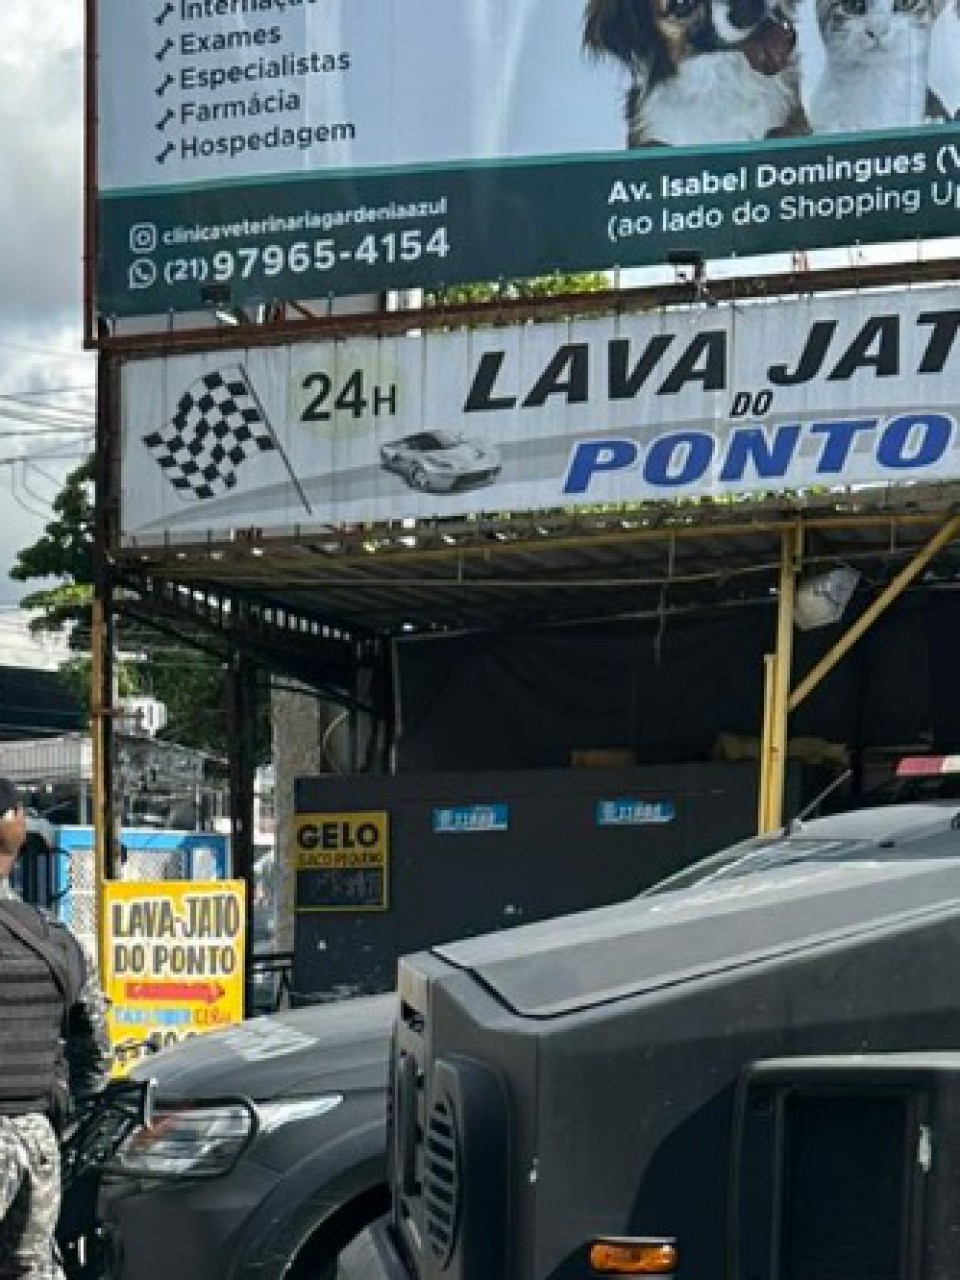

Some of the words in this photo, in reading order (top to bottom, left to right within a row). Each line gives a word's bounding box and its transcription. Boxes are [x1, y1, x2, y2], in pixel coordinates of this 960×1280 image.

[181, 25, 281, 55] Exames
[181, 52, 351, 90] Especialistas
[181, 89, 300, 125] Farmácia
[181, 122, 355, 160] Hospedagem
[607, 181, 653, 206] Av.
[661, 164, 748, 198] Isabel
[756, 152, 927, 190] Domingues
[162, 197, 448, 247] clinicaveterinariagardeniaazul
[607, 211, 653, 243] (ao
[662, 204, 725, 233] lado
[731, 201, 770, 226] do
[779, 186, 921, 220] Shopping
[461, 329, 728, 413] LAVA
[729, 389, 773, 418] DO
[562, 412, 953, 495] PONTO
[296, 821, 380, 850] GELO
[111, 893, 240, 938] LAVA-JATO
[114, 944, 146, 975] DO
[152, 944, 237, 975] PONTO
